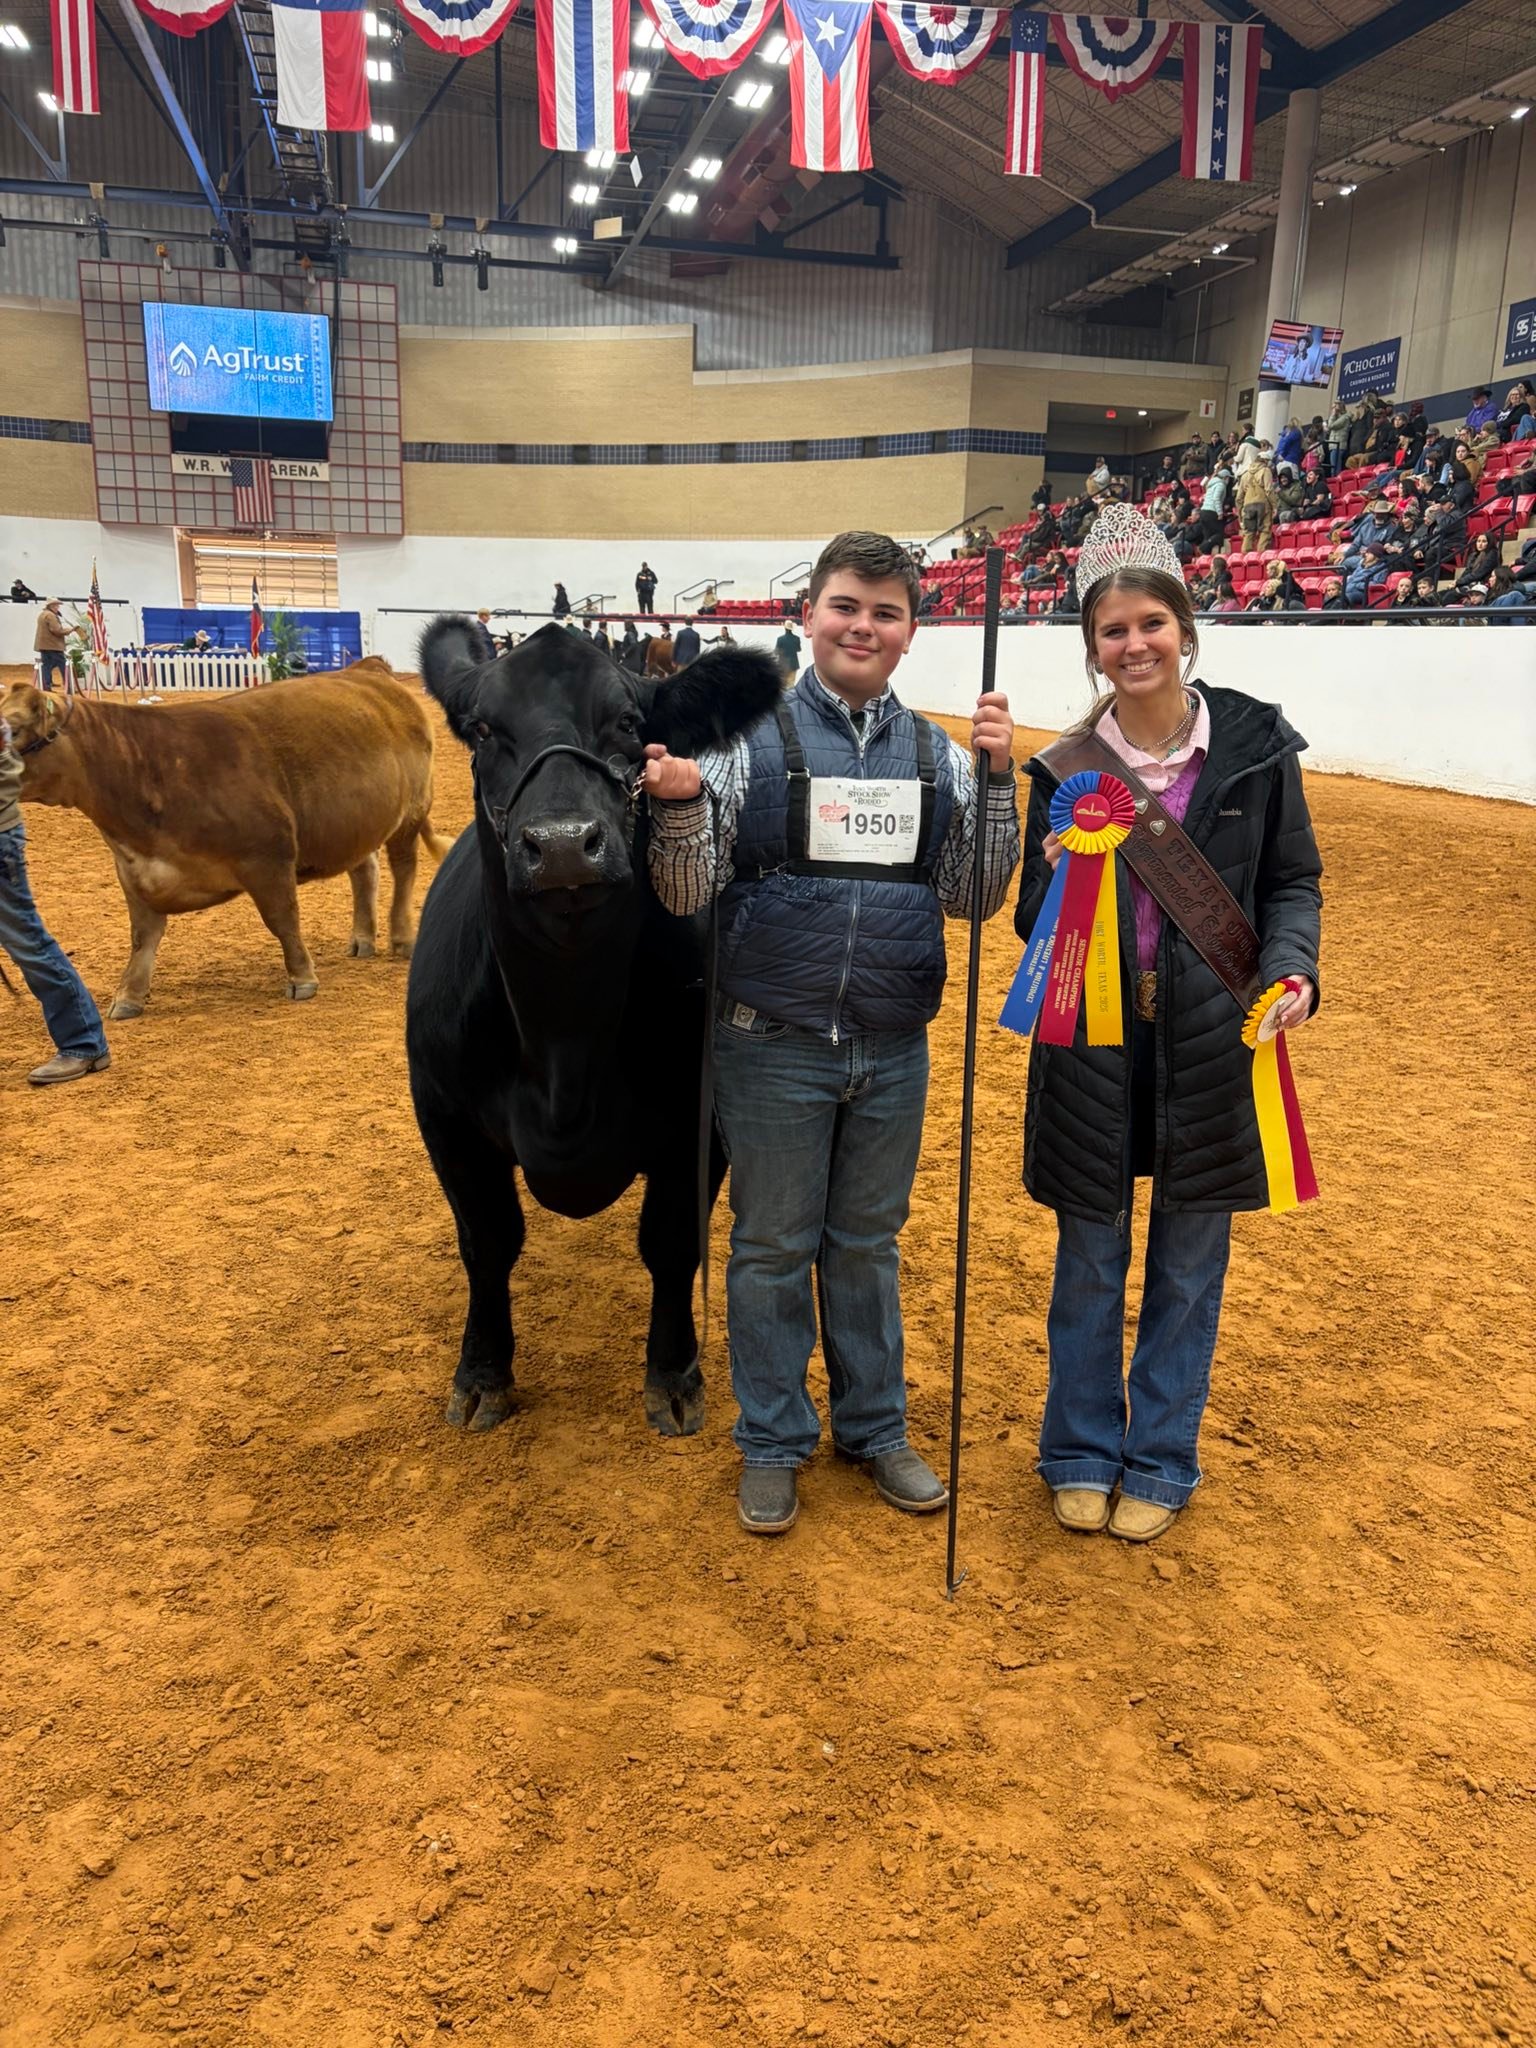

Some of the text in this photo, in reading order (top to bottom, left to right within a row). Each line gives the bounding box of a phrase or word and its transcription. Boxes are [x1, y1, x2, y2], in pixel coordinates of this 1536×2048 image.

[203, 344, 305, 374] AgTrust
[1348, 351, 1397, 375] CHOCTAW
[245, 373, 304, 385] FARM CREDIT
[183, 458, 215, 473] W.R.
[270, 463, 320, 478] ARENA
[841, 813, 896, 835] 1950
[1168, 838, 1230, 917] TEXAS
[1096, 921, 1104, 937] FORT
[1026, 972, 1043, 1003] EXPOSITION
[1041, 935, 1056, 964] LIVESTOCK
[1027, 939, 1045, 976] SOUTHWESTERN
[1069, 938, 1087, 1009] SENIOR CHAMPION
[1098, 972, 1108, 993] TEXAS
